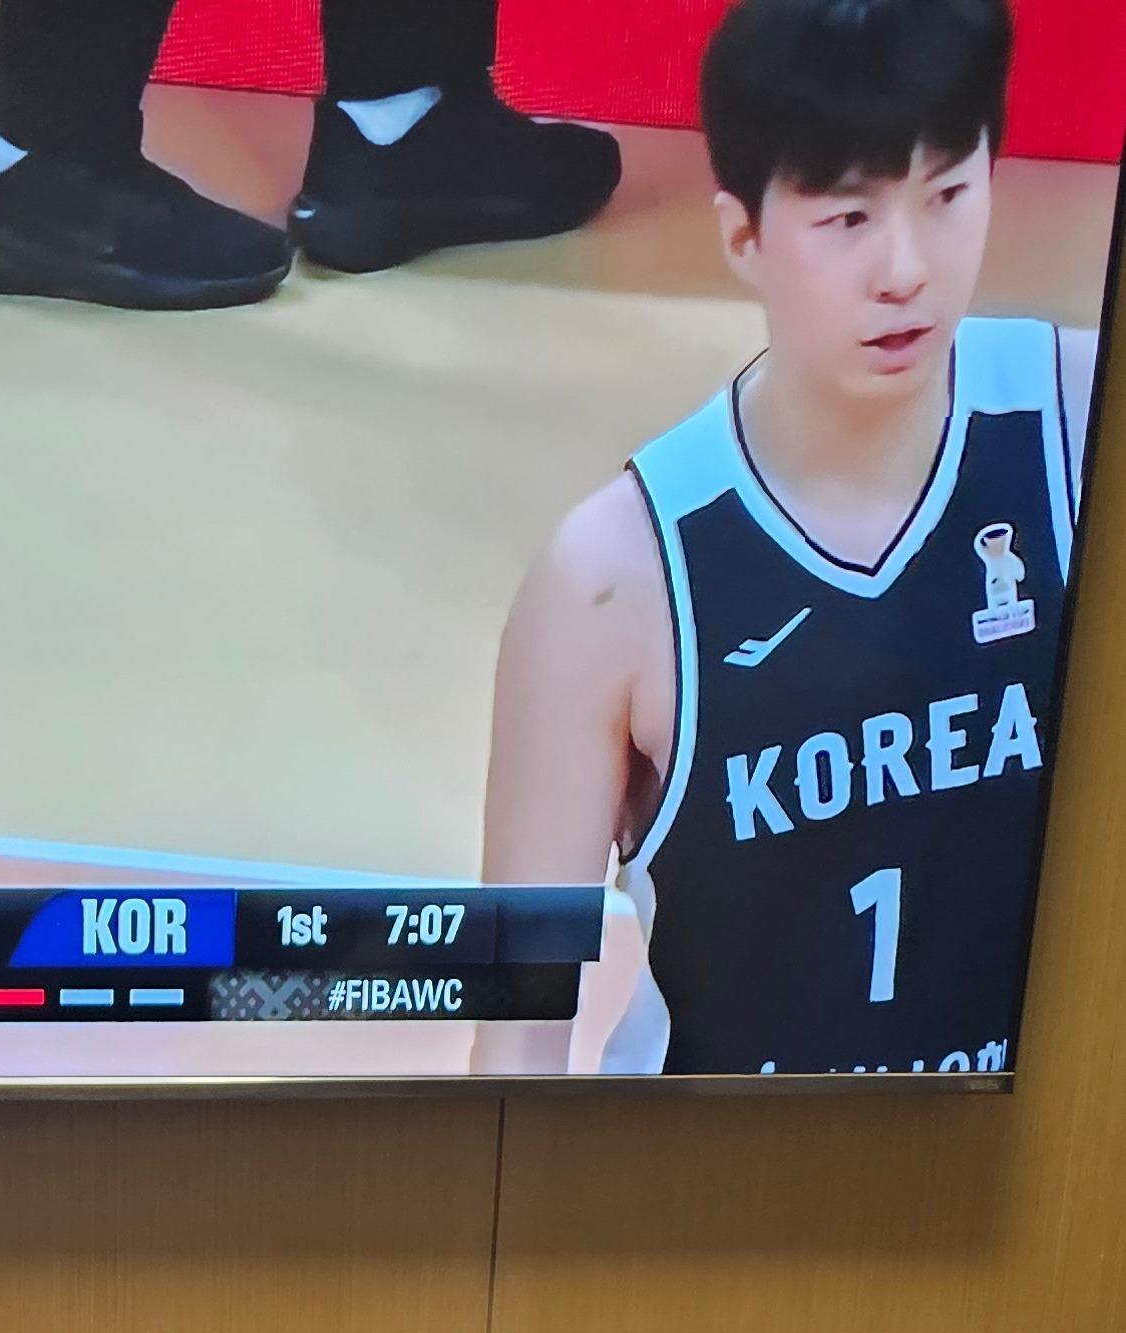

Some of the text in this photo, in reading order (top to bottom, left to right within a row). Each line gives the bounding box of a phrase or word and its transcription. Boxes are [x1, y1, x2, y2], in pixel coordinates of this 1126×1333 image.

[726, 683, 1043, 841] KOREA
[81, 898, 187, 955] KOR
[277, 904, 466, 946] 1st 7:07
[850, 867, 902, 1003] 1
[328, 978, 463, 1012] #FIBAWC
